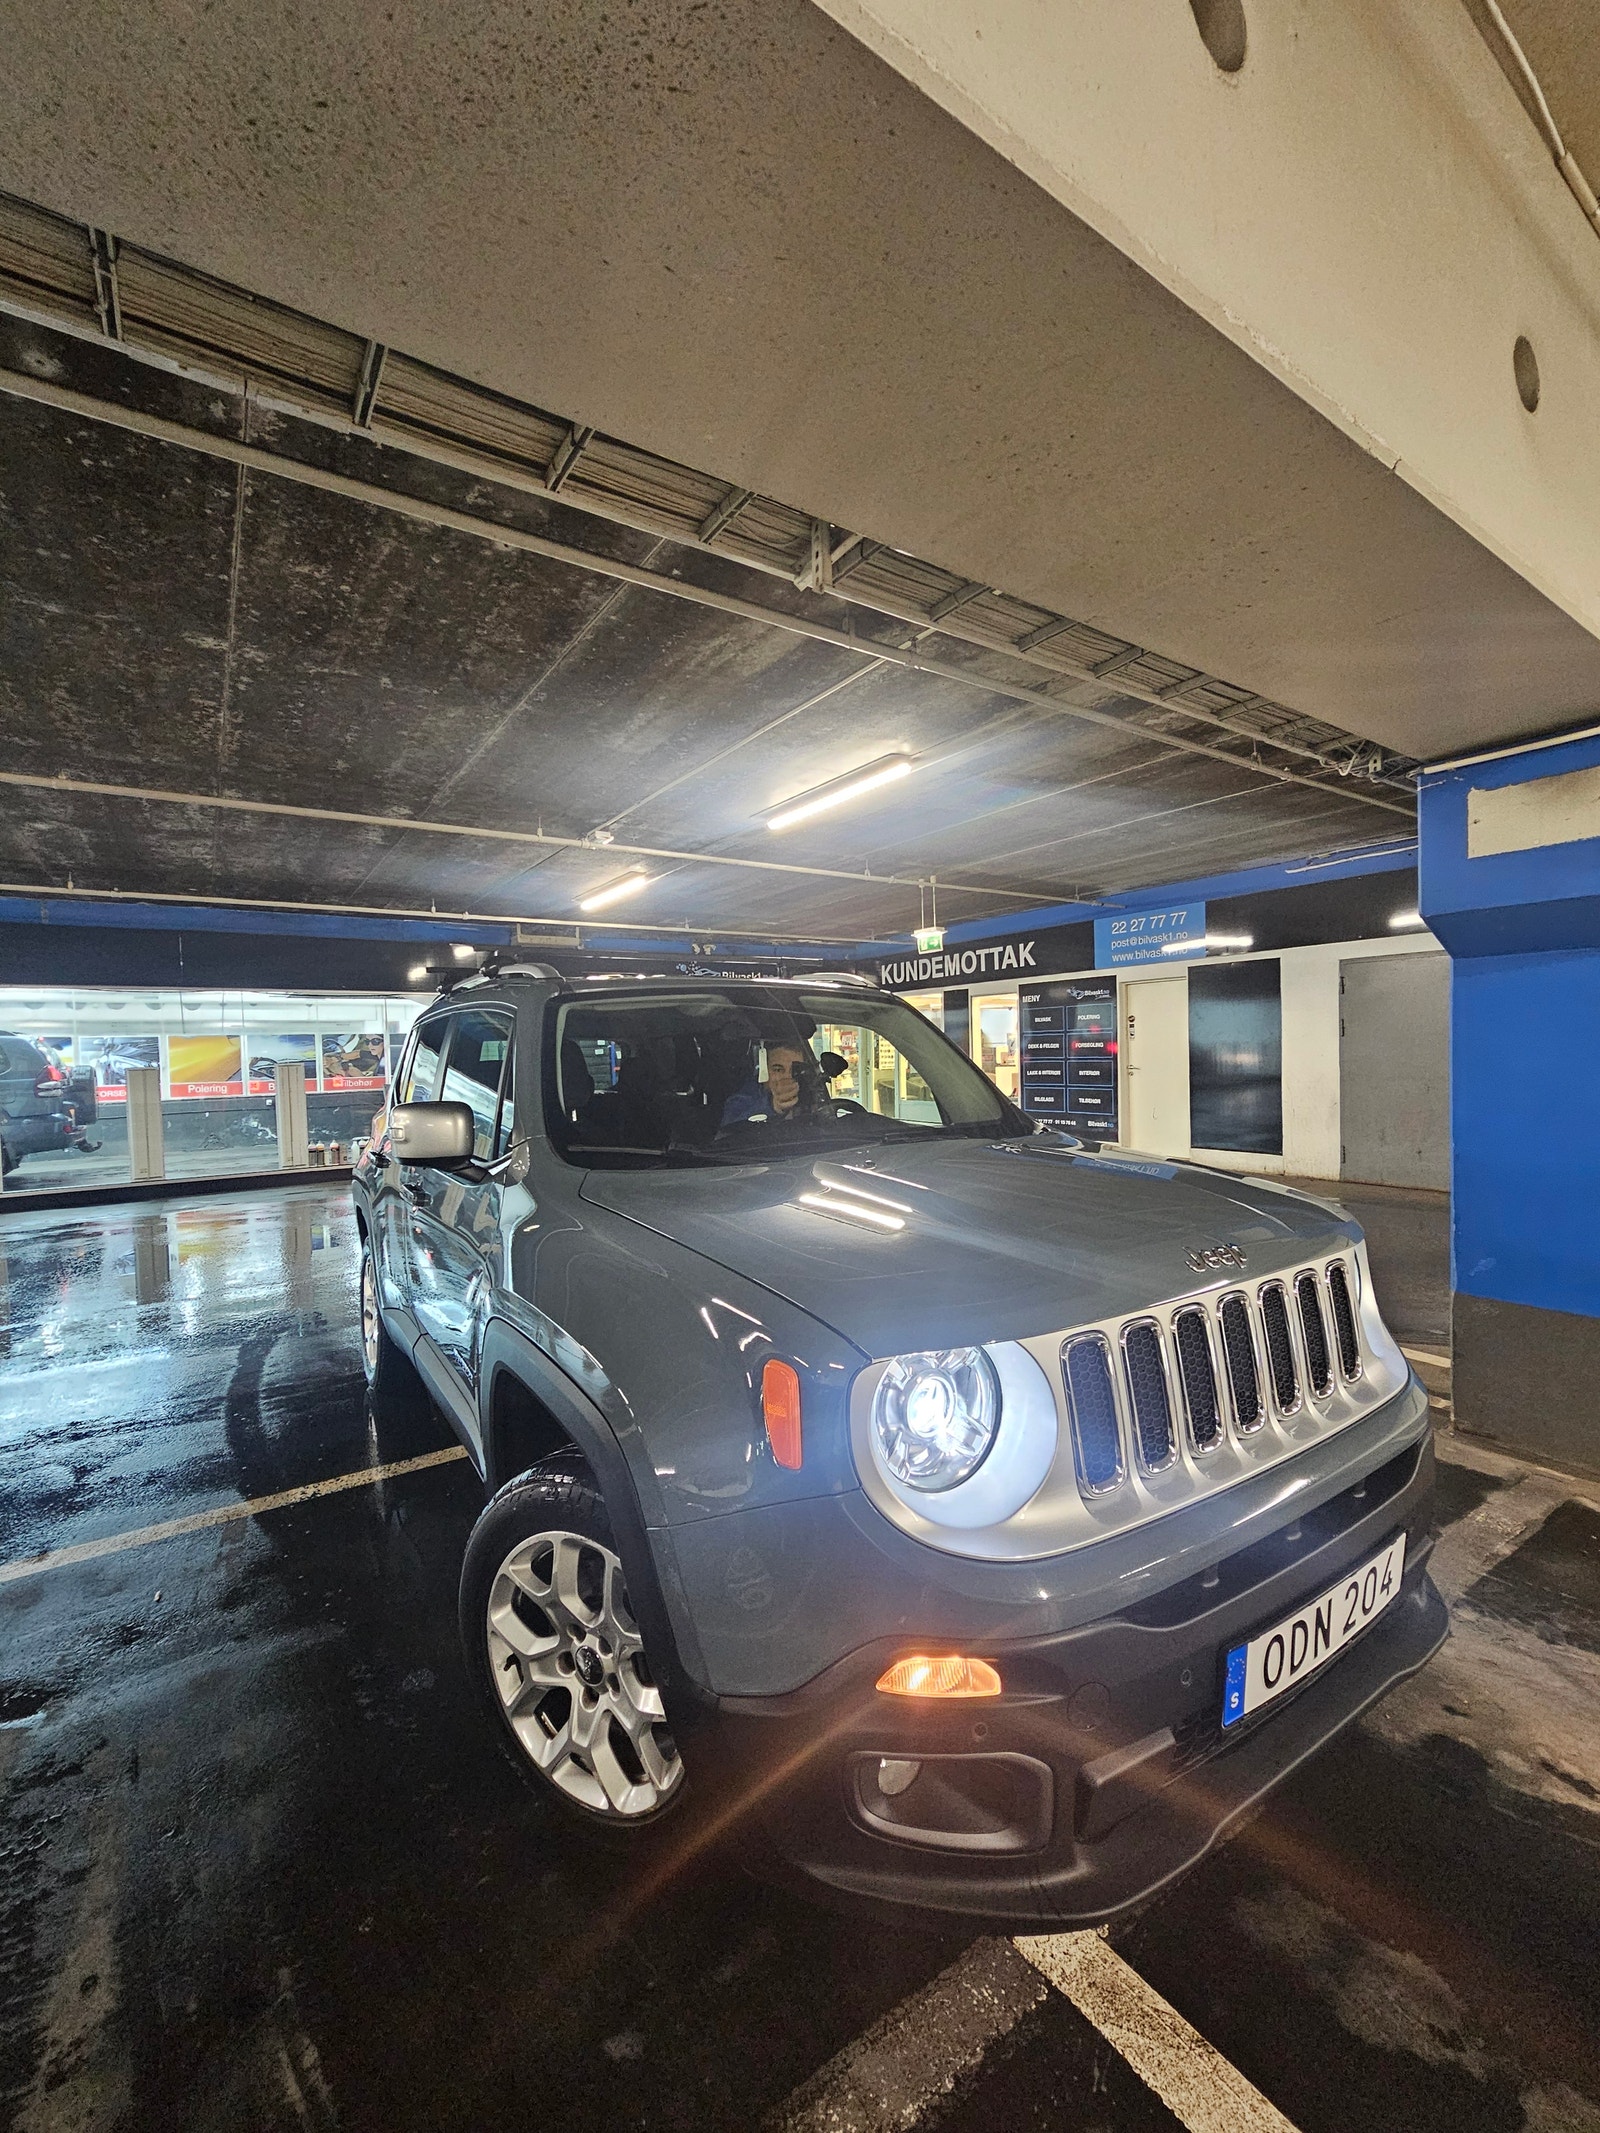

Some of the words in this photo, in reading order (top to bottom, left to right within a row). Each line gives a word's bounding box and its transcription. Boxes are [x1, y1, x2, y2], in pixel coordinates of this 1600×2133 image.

[1111, 921, 1127, 935] 22
[1130, 918, 1146, 933] 27
[1150, 914, 1167, 929] 77
[1170, 911, 1187, 926] 77
[1111, 932, 1188, 950] post@bilvask1.no
[881, 941, 1037, 985] KUNDEMOTTAK
[722, 971, 774, 979] Bilvask1no
[1022, 995, 1041, 1003] MENY
[187, 1084, 228, 1094] Polering
[341, 1079, 373, 1088] ilbehør
[1182, 1243, 1248, 1274] Jeep
[1263, 1598, 1333, 1689] ODN
[1342, 1551, 1393, 1636] 204
[1230, 1692, 1240, 1709] S
